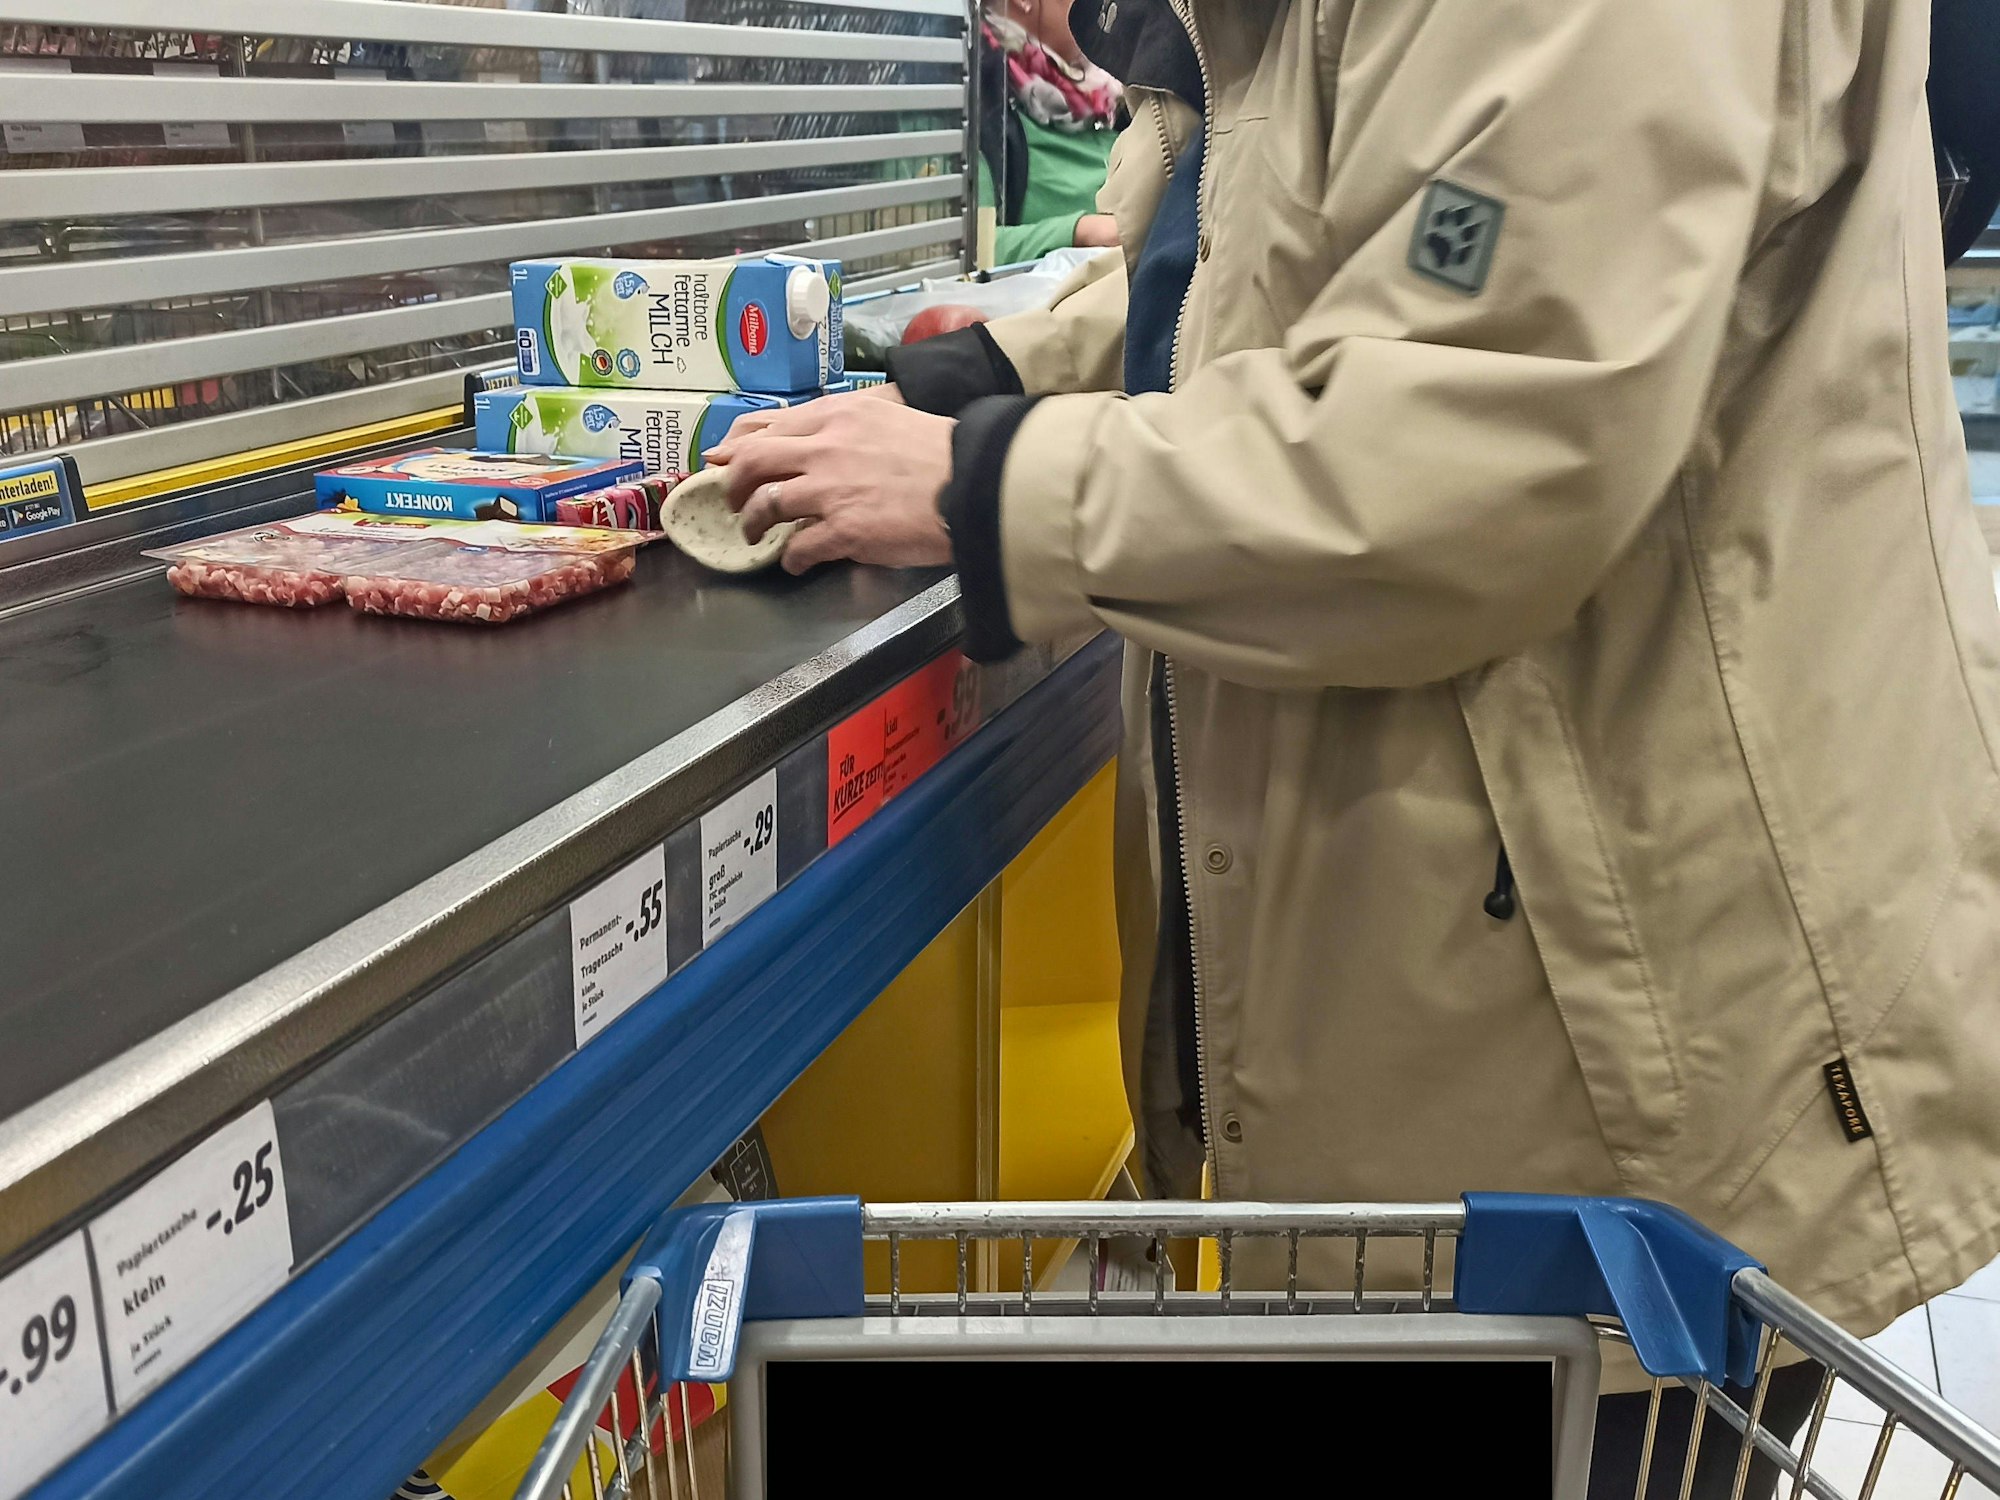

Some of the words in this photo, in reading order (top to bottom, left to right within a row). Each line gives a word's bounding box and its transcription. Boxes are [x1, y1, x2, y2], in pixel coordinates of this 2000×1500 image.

[512, 268, 528, 285] 1L
[648, 293, 674, 365] MILCH
[674, 274, 691, 348] fettarme
[694, 273, 709, 341] haltbare
[748, 303, 761, 356] Milbona
[646, 410, 663, 475] fettarm
[666, 410, 683, 475] haltbare
[26, 509, 49, 521] Google
[47, 507, 60, 516] Play
[385, 492, 453, 512] KONFEKT
[886, 717, 898, 737] Lidl
[839, 752, 855, 782] FÜR
[834, 769, 866, 814] KURZE
[708, 830, 742, 860] Papiertasche
[744, 804, 773, 856] -.29
[709, 864, 726, 890] groß
[625, 879, 663, 942] -.55
[714, 896, 727, 912] Stück
[580, 915, 622, 950] Permanent-
[581, 942, 623, 979] Tragetasche
[581, 981, 596, 997] klein
[588, 988, 605, 1007] Stück
[206, 1140, 273, 1235] -.25
[117, 1208, 198, 1277] Papiertasche
[123, 1273, 166, 1317] klein
[696, 1284, 729, 1368] wanzl
